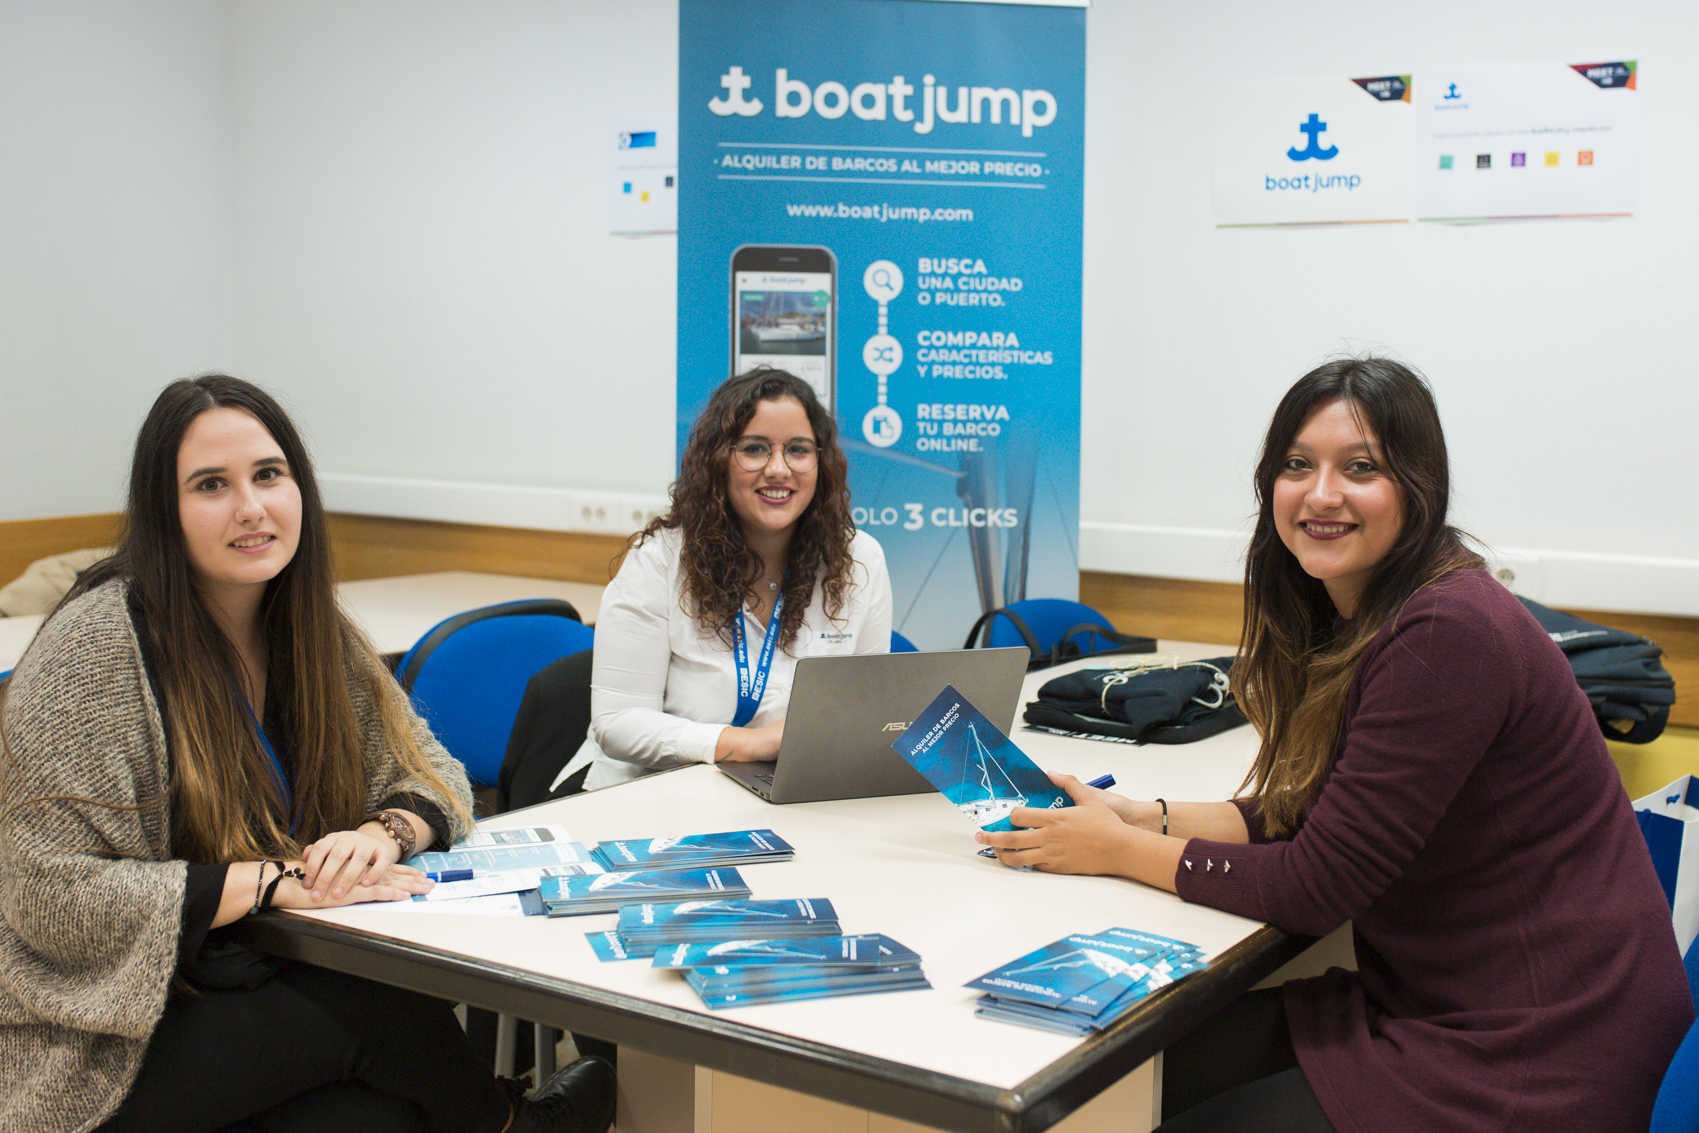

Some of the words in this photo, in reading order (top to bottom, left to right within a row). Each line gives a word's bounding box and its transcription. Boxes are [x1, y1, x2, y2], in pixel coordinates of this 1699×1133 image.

[721, 154, 802, 170] ALQUILER
[805, 156, 828, 170] DE
[831, 157, 898, 172] BARCOS
[900, 159, 922, 173] AL
[925, 160, 981, 175] MEJOR
[983, 161, 1042, 178] PRECIO
[786, 202, 974, 223] www.boatjump.com
[918, 257, 988, 275] BUSCA
[917, 275, 954, 290] UNA
[957, 276, 1023, 292] CIUDAD
[917, 291, 931, 305] O
[934, 291, 1006, 307] PUERTO.
[917, 330, 1020, 348] COMPARA
[917, 346, 1054, 365] CARACTERÍSTICAS
[916, 364, 928, 379] Y
[931, 364, 1009, 380] PRECIOS.
[916, 403, 1011, 421] RESERVA
[915, 421, 938, 436] TU
[942, 422, 1001, 437] BARCO
[915, 437, 985, 453] ONLINE.
[851, 506, 898, 526] OLO
[903, 502, 924, 532] 3
[930, 507, 1018, 528] CLICKS
[881, 721, 913, 732] ASU
[910, 731, 934, 756] ALQUILER
[932, 723, 942, 733] DE
[940, 702, 960, 725] BARCOS
[928, 729, 944, 748] MEJOR
[942, 713, 960, 732] PRECIO
